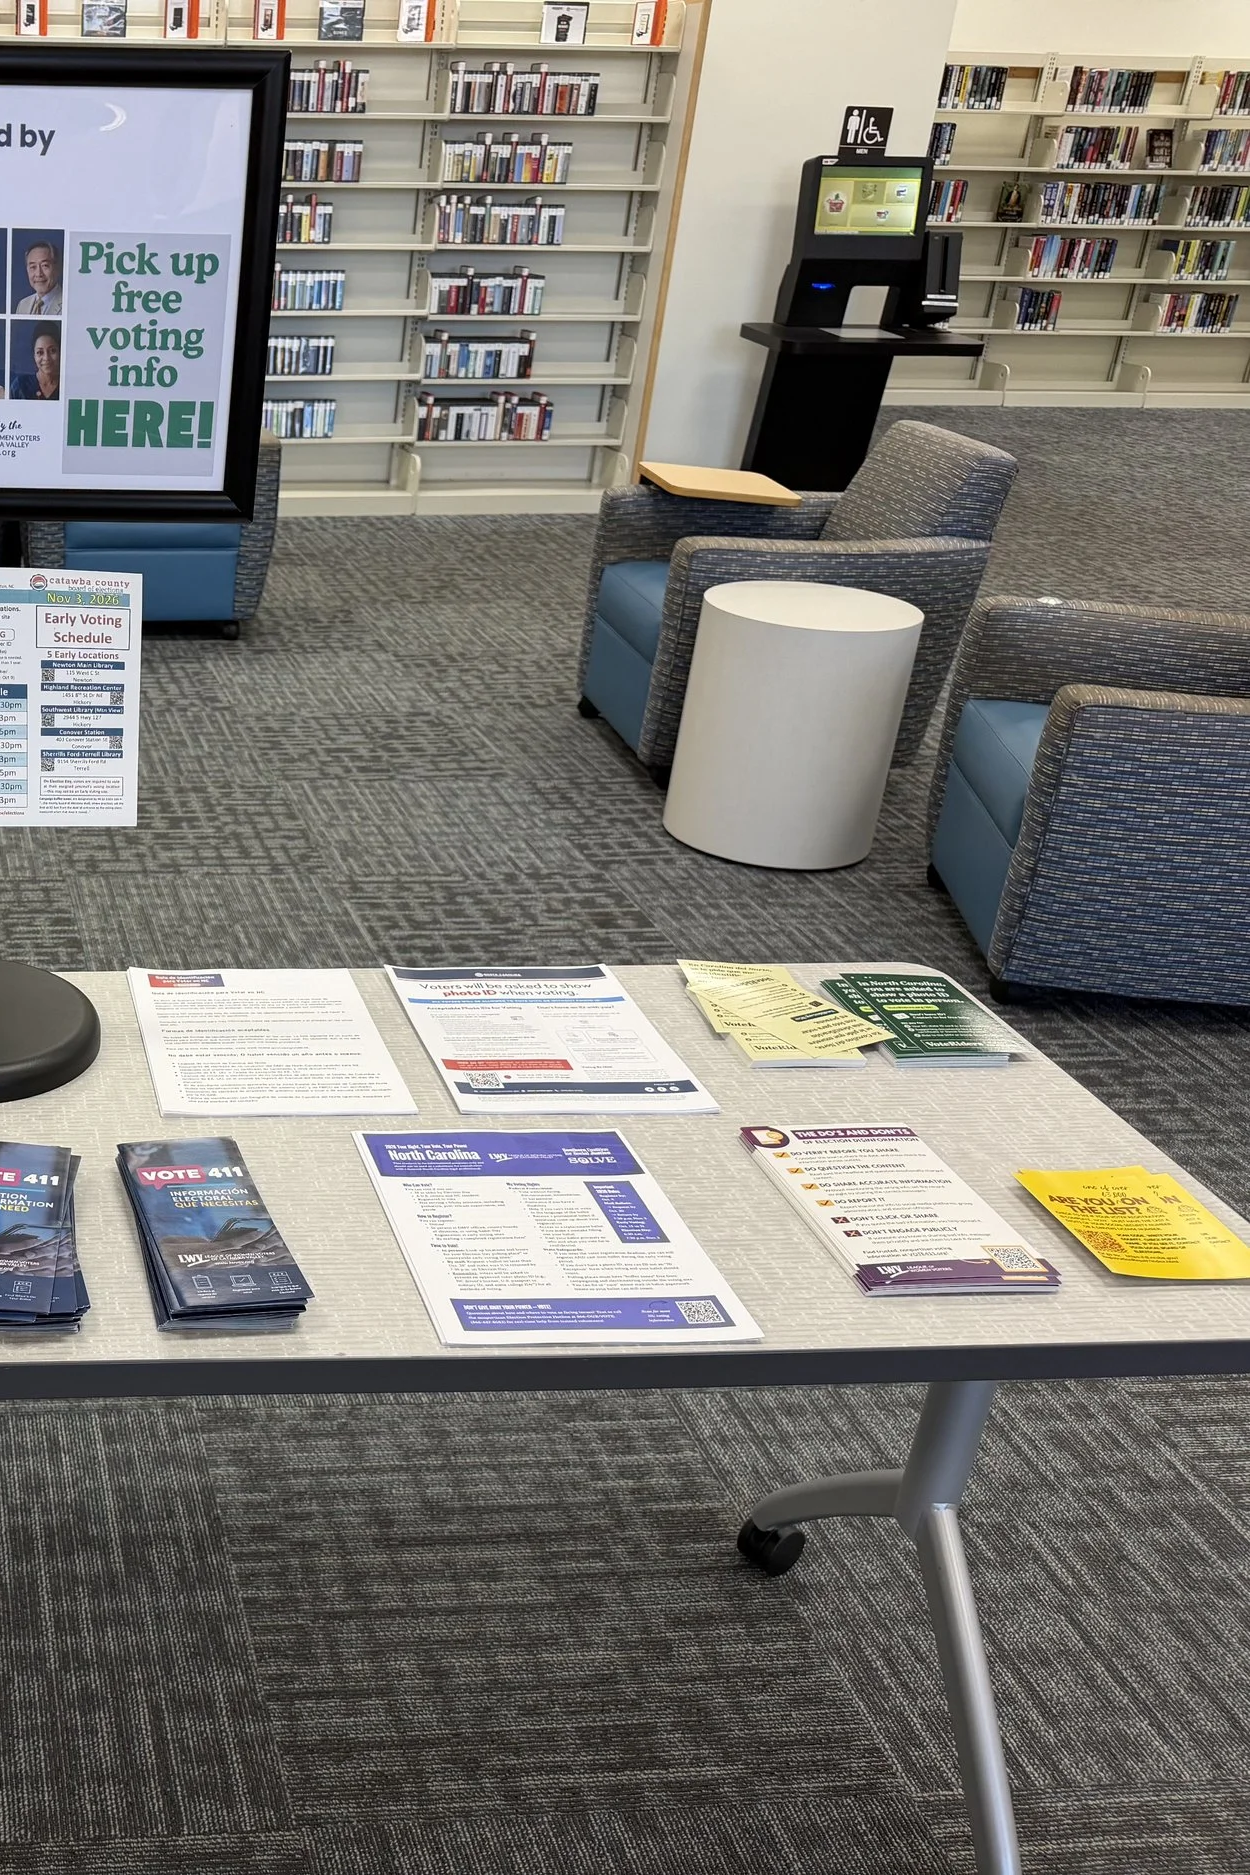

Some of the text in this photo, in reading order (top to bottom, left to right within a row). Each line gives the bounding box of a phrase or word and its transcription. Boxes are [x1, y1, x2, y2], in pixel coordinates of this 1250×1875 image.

[20, 124, 56, 156] by
[79, 242, 220, 283] Pick up
[112, 281, 182, 314] free
[88, 320, 205, 359] voting
[108, 356, 178, 388] info
[8, 421, 22, 430] the
[67, 399, 213, 449] HERE!
[50, 577, 130, 588] catawba county
[47, 593, 119, 605] Nov 3, 2026
[45, 613, 122, 628] Early Voting
[54, 632, 112, 643] Schedule
[55, 651, 75, 660] Early
[79, 651, 119, 659] Locations
[0, 715, 16, 723] 3pm
[388, 1149, 480, 1161] North Carolina
[23, 1172, 60, 1186] 411
[142, 1166, 244, 1182] VOTE 411
[169, 1187, 249, 1198] INFORMACIÓN
[171, 1195, 234, 1203] ELECTORAL
